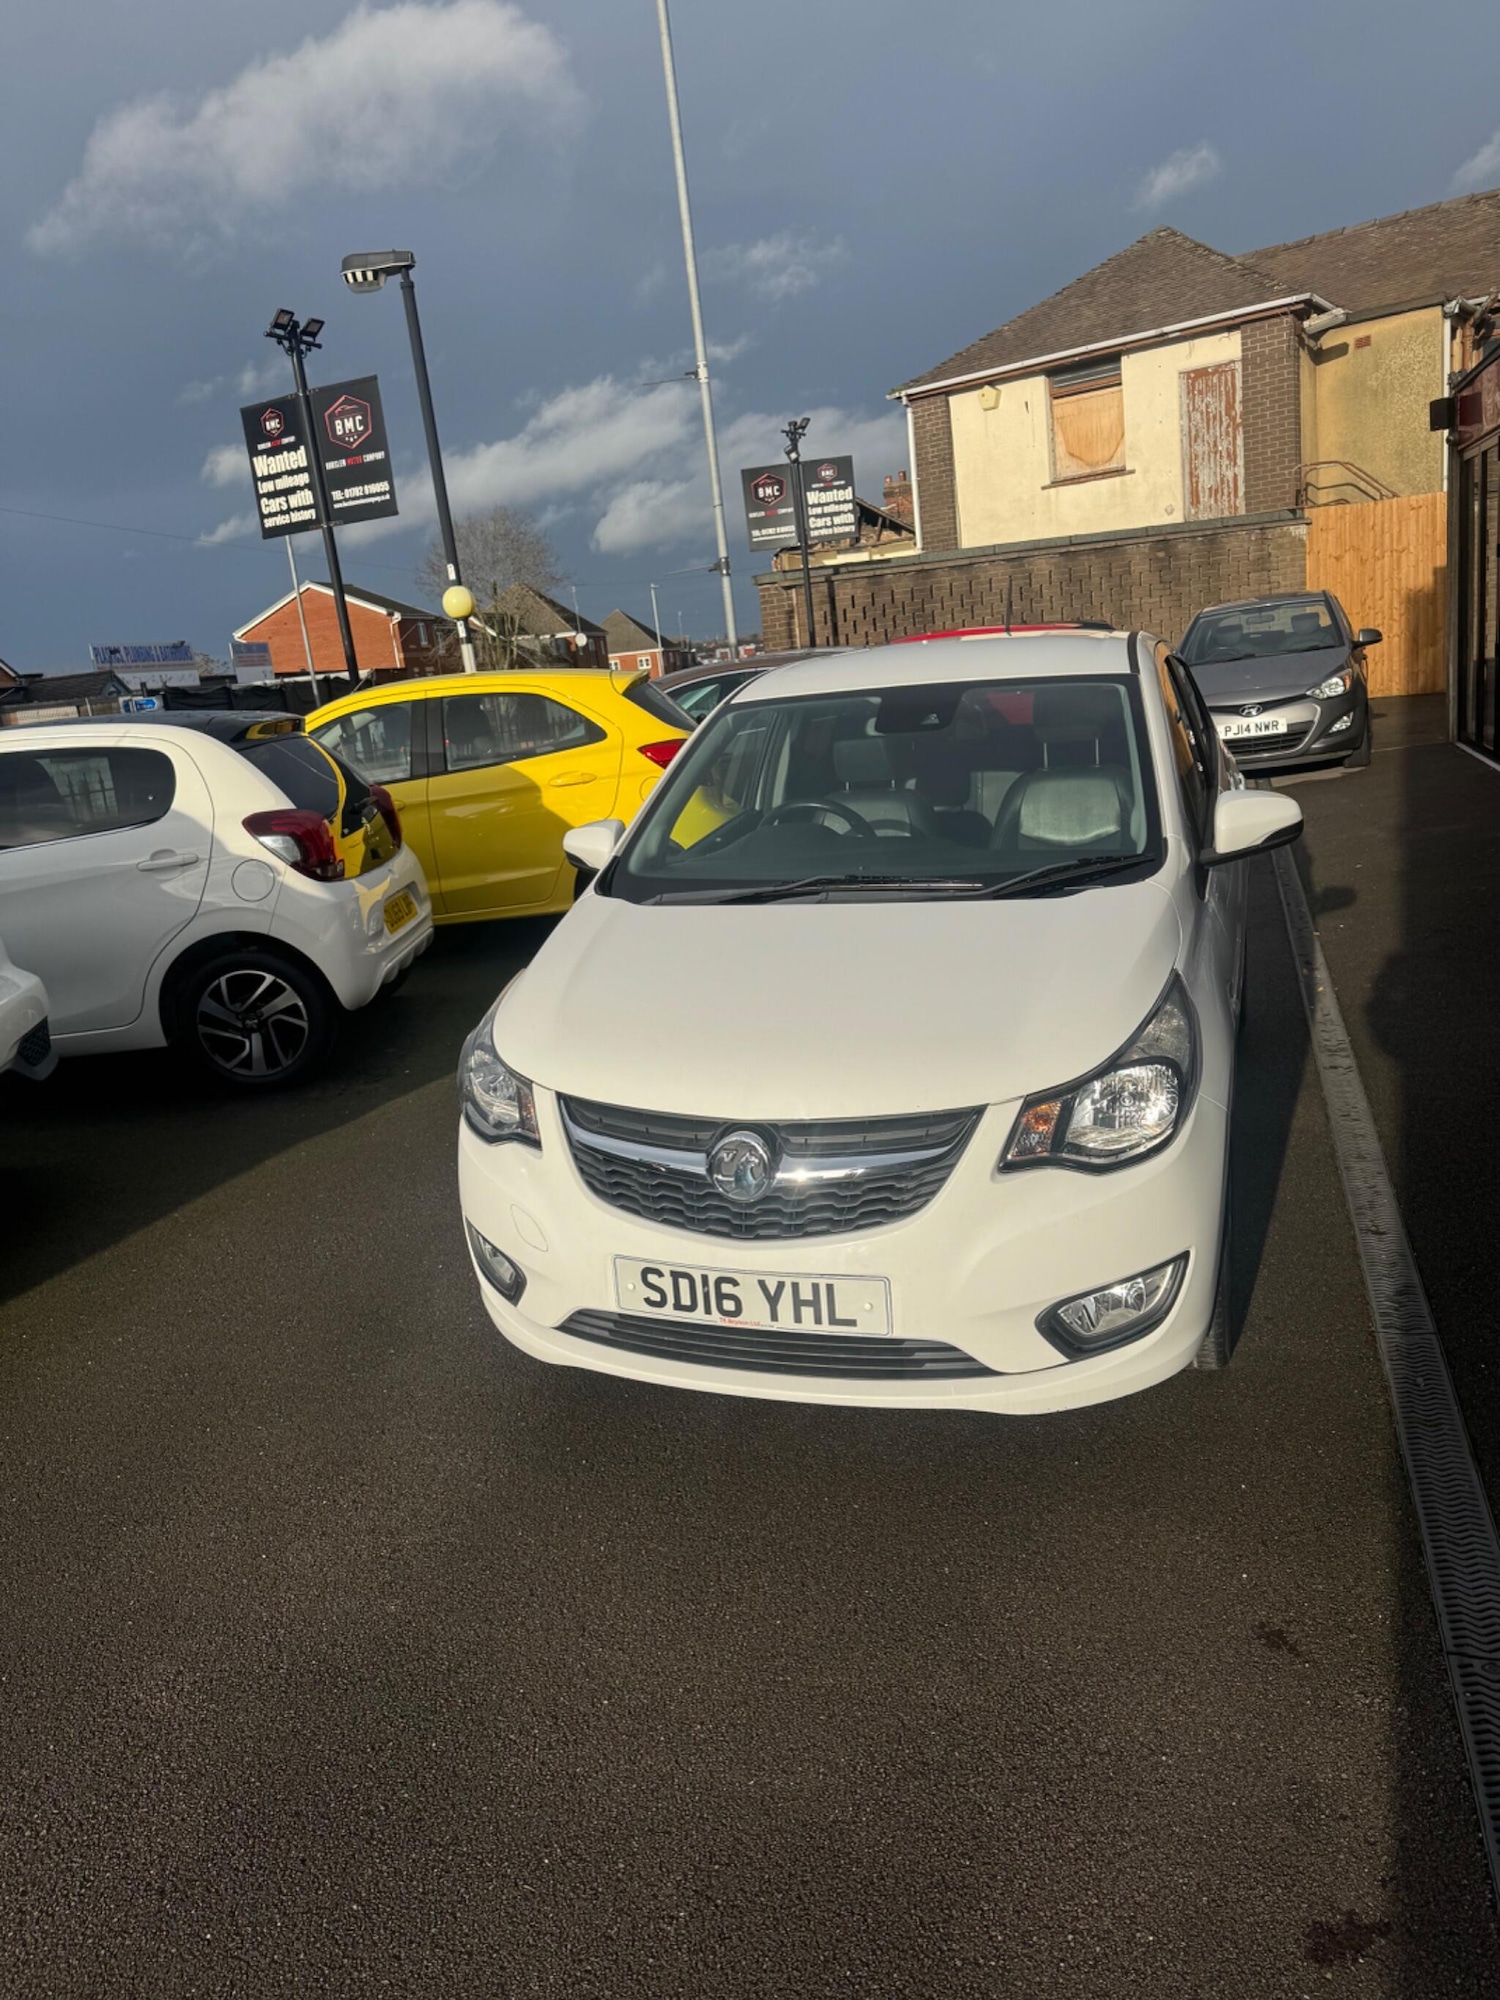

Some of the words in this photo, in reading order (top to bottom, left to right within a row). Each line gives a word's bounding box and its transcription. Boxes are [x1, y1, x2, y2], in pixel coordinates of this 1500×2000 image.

[335, 415, 364, 435] BMC
[252, 445, 308, 478] Wanted
[257, 480, 275, 494] Low
[275, 472, 310, 491] mileage
[757, 485, 780, 498] BMC
[260, 496, 288, 515] Cars
[288, 488, 314, 509] with
[806, 485, 853, 505] Wanted
[263, 514, 290, 528] service
[290, 508, 316, 523] history
[809, 516, 832, 529] Cars
[832, 513, 855, 525] with
[1225, 724, 1250, 736] PJ14
[1255, 720, 1279, 732] NWR
[640, 1266, 743, 1318] SD16
[757, 1279, 858, 1328] YHL
